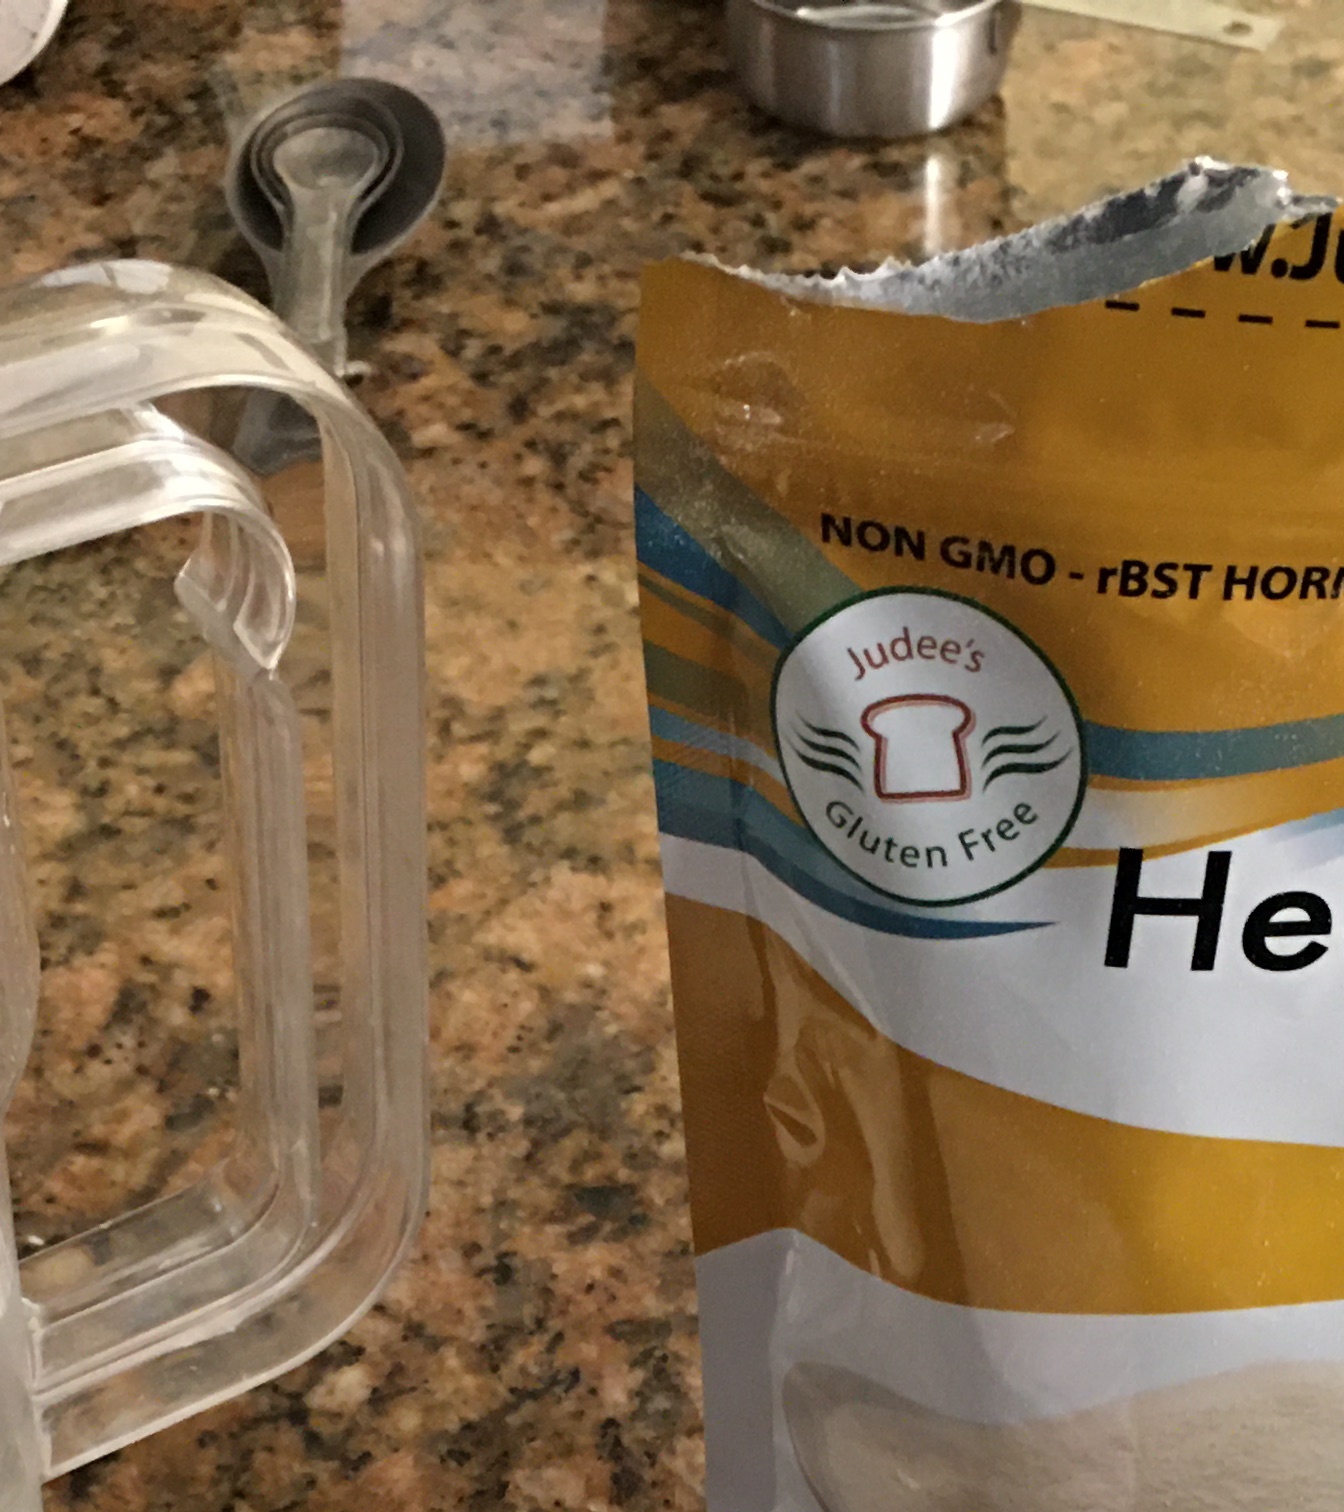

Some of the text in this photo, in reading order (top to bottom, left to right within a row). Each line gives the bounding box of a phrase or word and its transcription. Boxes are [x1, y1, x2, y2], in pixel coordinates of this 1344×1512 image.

[820, 512, 927, 561] NON
[939, 534, 1058, 586] GMO
[1096, 559, 1212, 600] rBST
[846, 625, 986, 681] Judee's
[824, 799, 1040, 869] Gluten Free
